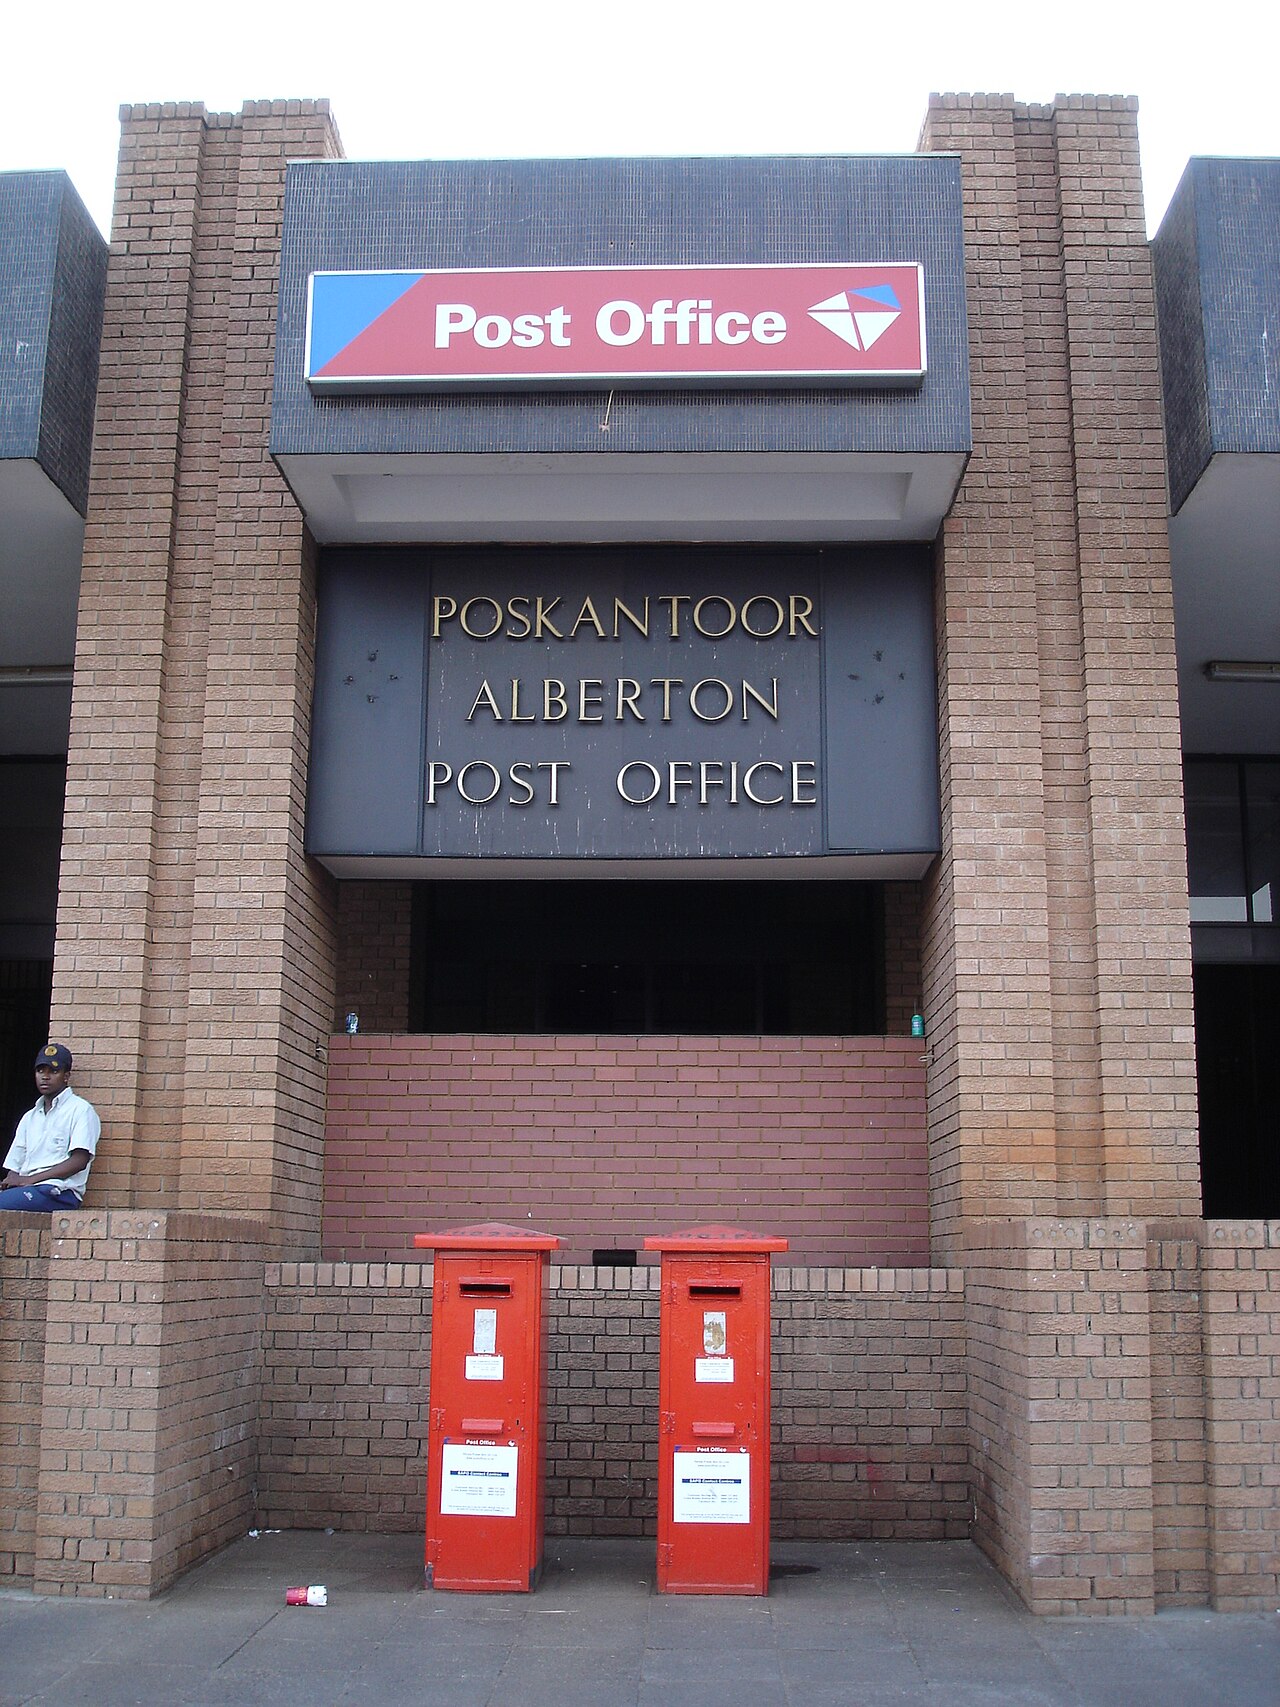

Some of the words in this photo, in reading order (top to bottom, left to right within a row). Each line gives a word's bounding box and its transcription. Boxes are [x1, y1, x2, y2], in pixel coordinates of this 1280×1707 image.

[435, 304, 571, 348] Post
[596, 300, 787, 346] Office
[431, 595, 819, 639] POSKANTOOR
[466, 677, 780, 722] ALBERTON
[427, 760, 571, 806] POST
[616, 760, 818, 806] OFFICE
